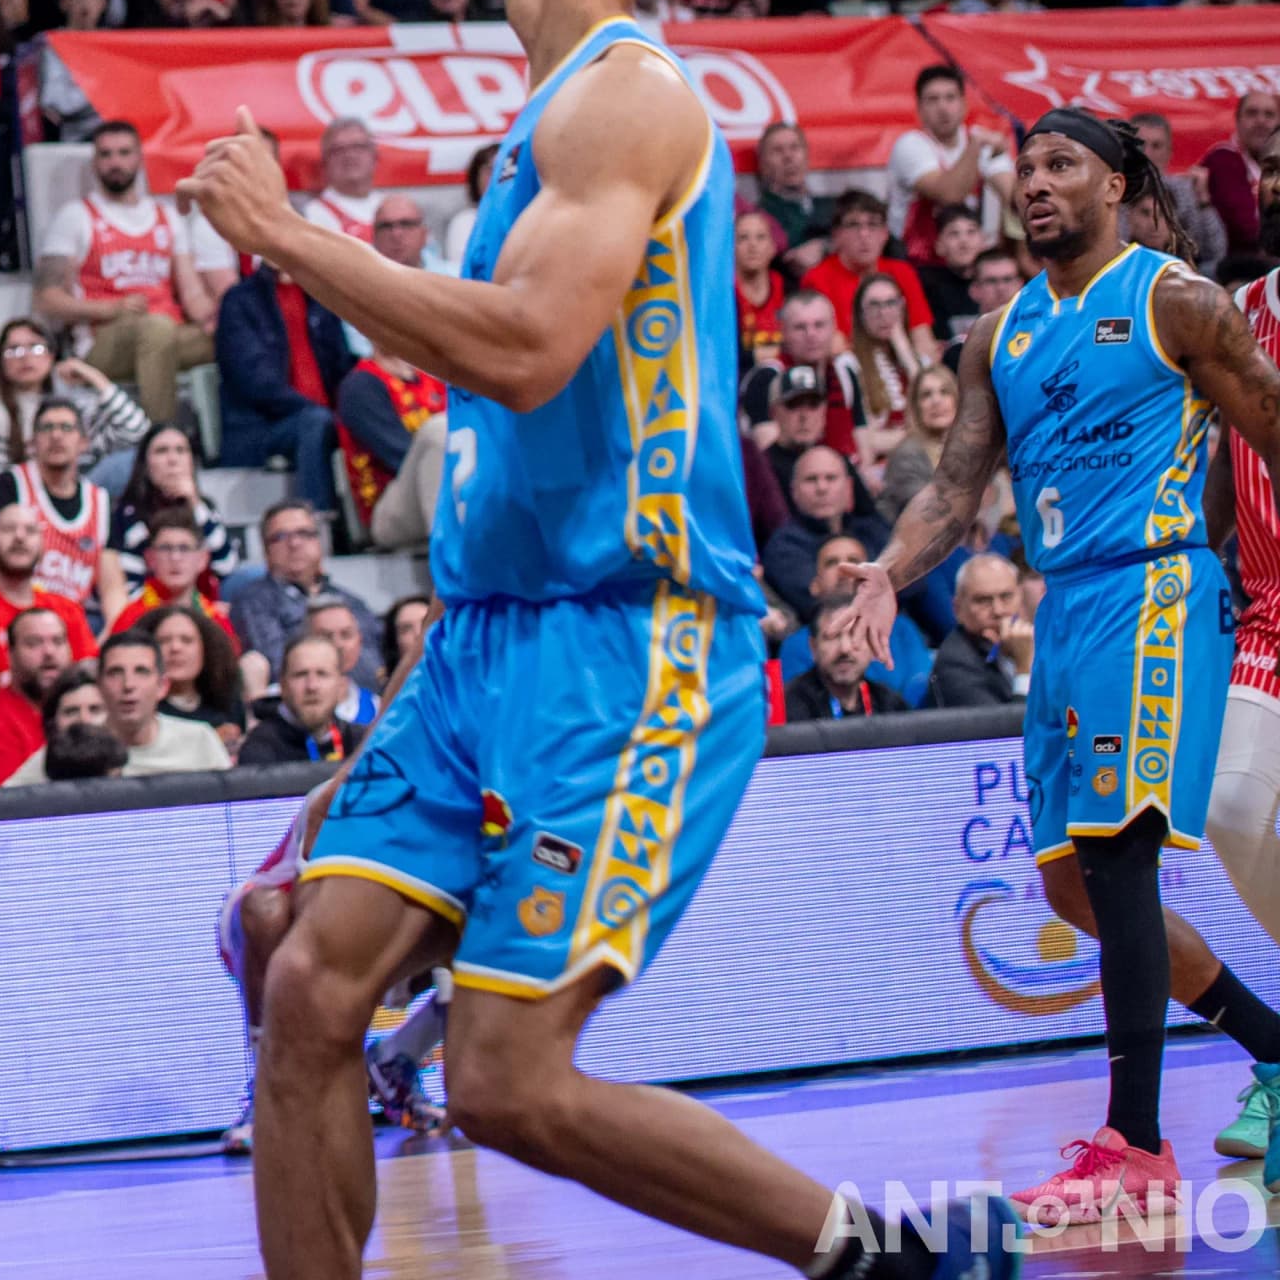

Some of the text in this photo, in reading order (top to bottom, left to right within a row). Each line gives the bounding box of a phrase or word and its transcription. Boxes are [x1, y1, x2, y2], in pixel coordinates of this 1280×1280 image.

[1035, 486, 1065, 549] 6
[40, 548, 94, 585] CAM
[1094, 741, 1118, 752] acb
